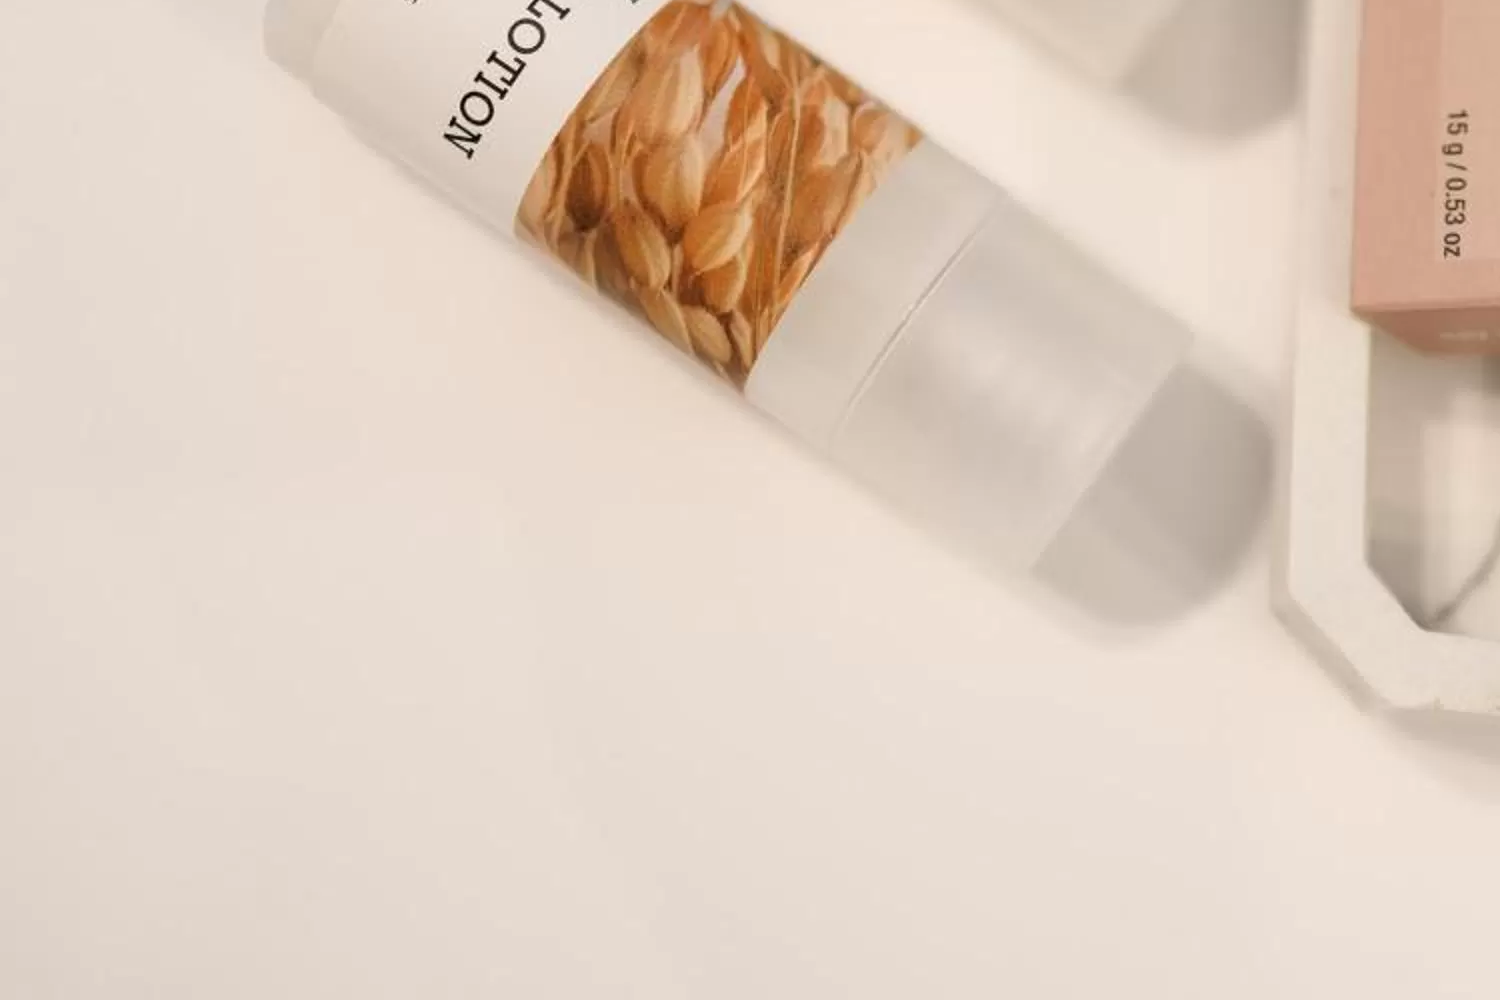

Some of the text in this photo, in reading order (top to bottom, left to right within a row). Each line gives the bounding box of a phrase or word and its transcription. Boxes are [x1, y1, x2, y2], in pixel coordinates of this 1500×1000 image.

[1441, 108, 1469, 259] 15 g / 0.53 oz
